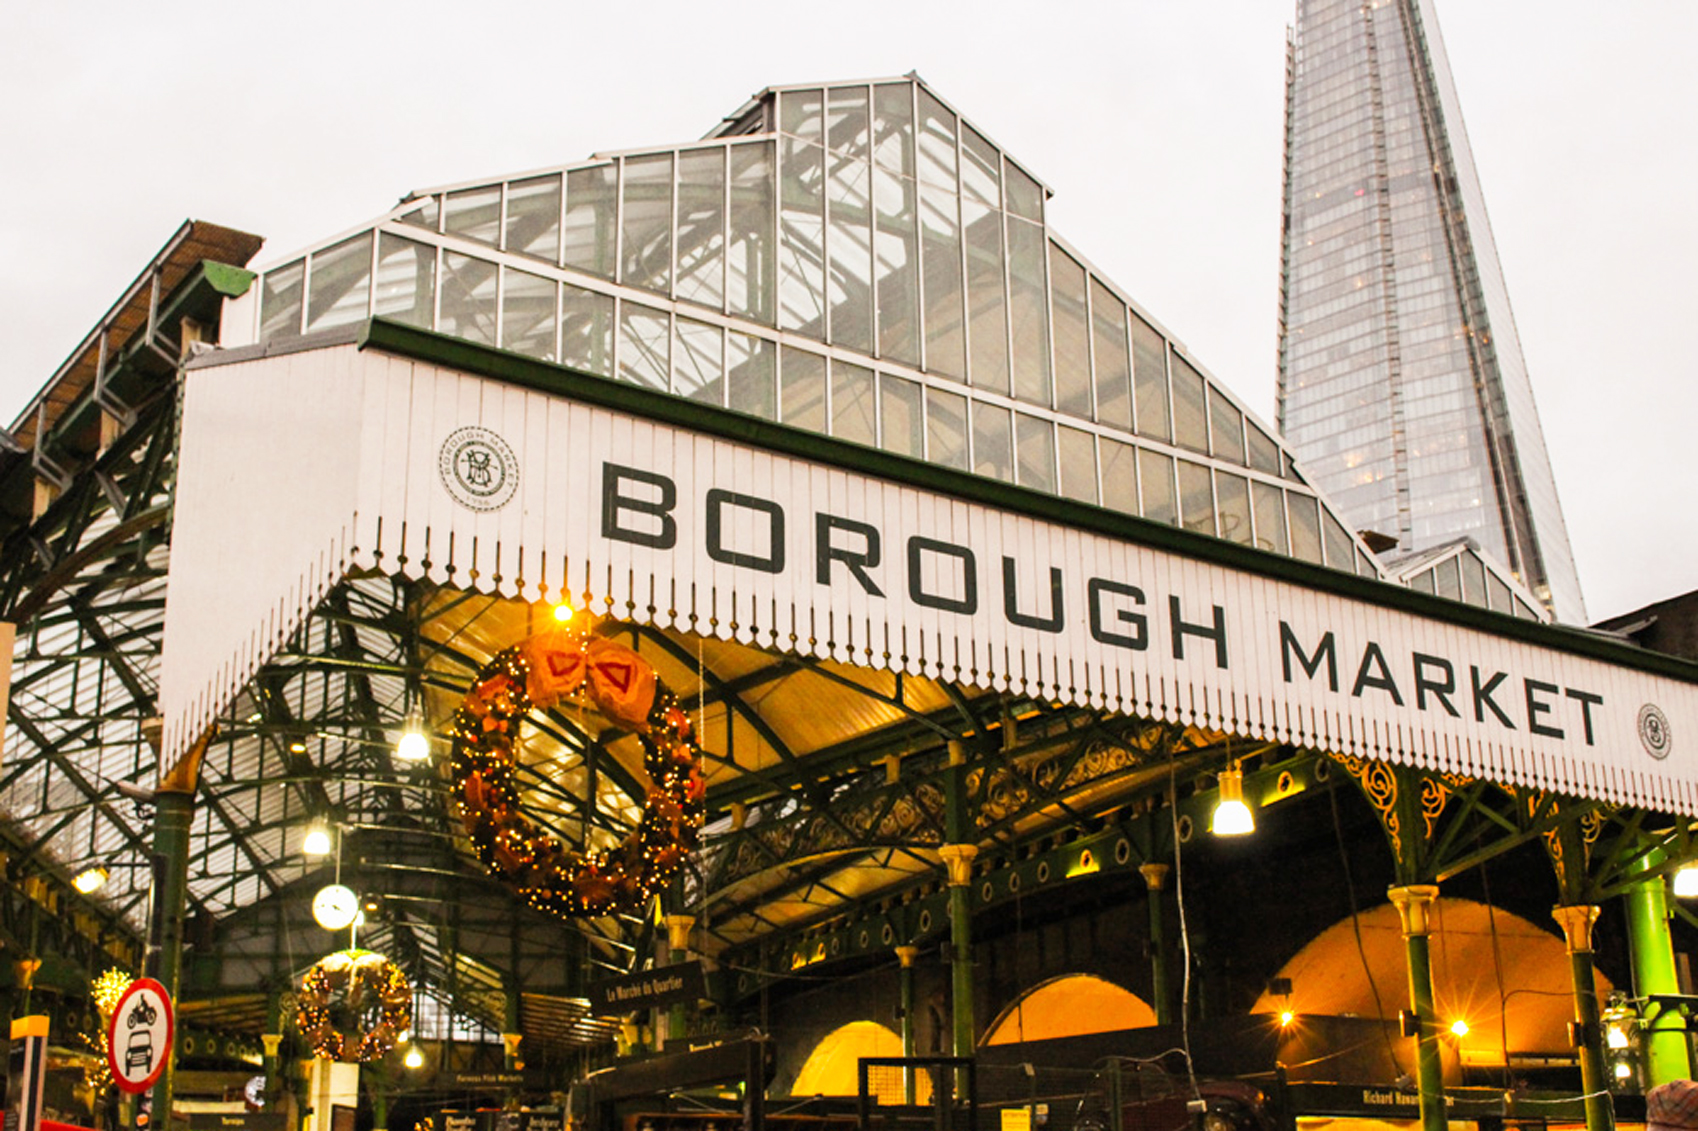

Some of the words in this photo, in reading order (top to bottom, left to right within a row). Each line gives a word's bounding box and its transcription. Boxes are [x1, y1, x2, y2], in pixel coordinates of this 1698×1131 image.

[443, 432, 484, 475] BOROUGH
[601, 461, 1229, 669] BOROUGH
[1279, 619, 1604, 747] MARKET
[1362, 1089, 1394, 1105] Richard
